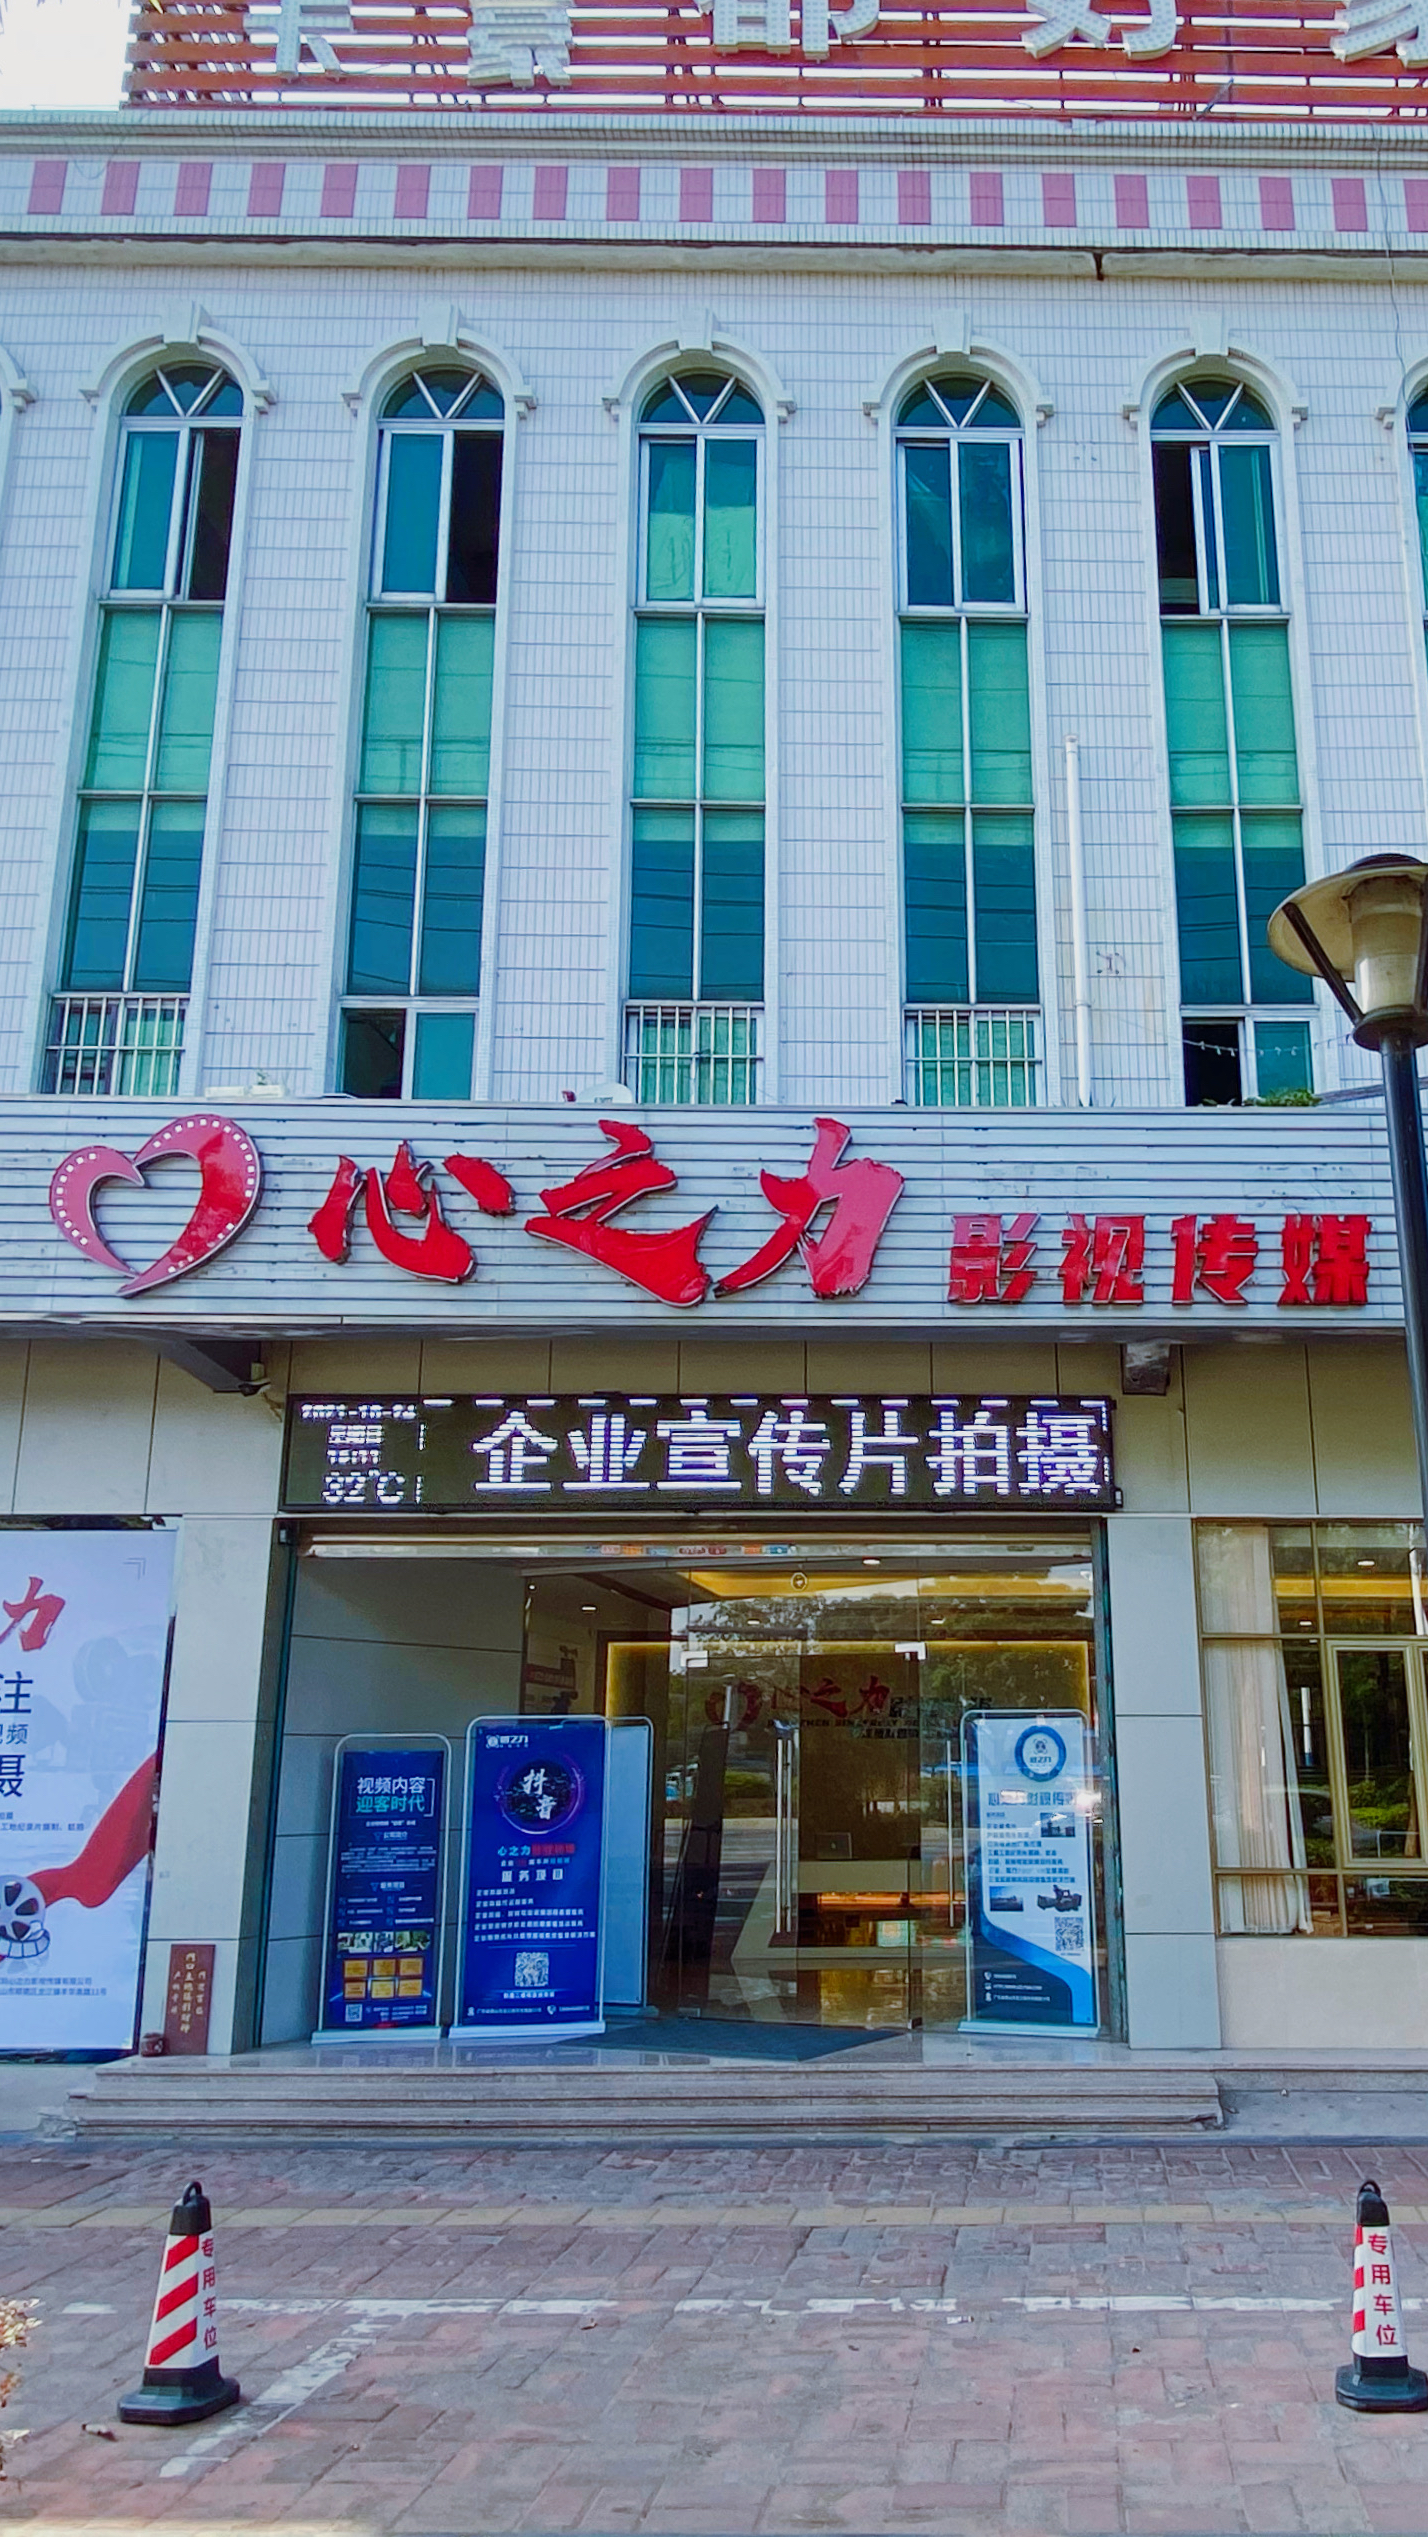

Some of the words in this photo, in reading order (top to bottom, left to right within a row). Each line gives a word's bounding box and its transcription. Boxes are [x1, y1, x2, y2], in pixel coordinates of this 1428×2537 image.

[306, 1117, 905, 1308] 心之力
[947, 1213, 1373, 1307] 影视传媒
[472, 1411, 1102, 1495] 企业宣传片拍摄
[0, 1576, 66, 1652] 力
[0, 1723, 29, 1745] 频
[355, 1794, 426, 1813] 迎客时代
[357, 1776, 426, 1795] 视频内容
[201, 2237, 218, 2351] 专用车位
[1367, 2233, 1399, 2346] 专用车位
